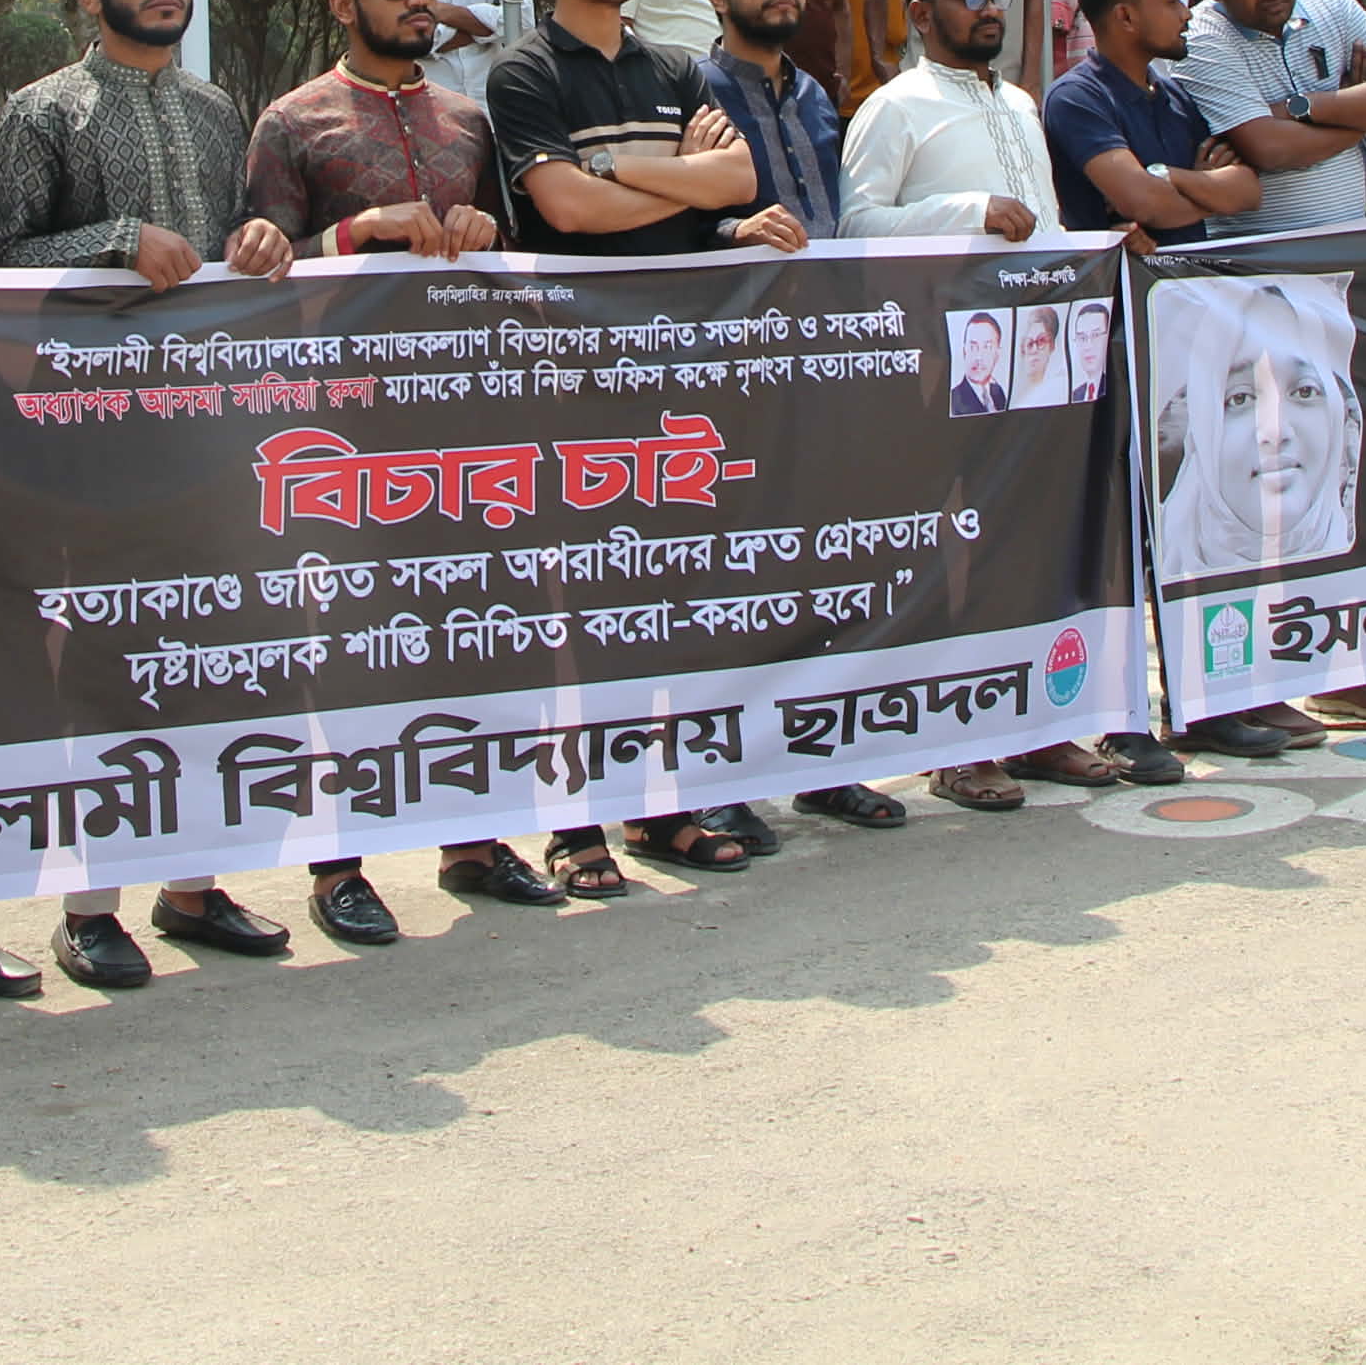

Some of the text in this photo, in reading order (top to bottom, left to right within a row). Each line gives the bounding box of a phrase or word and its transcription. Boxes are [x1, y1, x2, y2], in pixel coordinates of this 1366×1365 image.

[13, 348, 922, 425] অধ্যাপক আসমা সাদিয়া রুনা ম্যামকে তাঁর নিজ অফিস কক্ষে নৃশংস হত্যাকাণ্ডের
[160, 331, 344, 377] বিশ্ববিদ্যালয়ের
[349, 325, 492, 363] সমাজকল্যাণ
[497, 318, 602, 356] বিভাগের
[607, 314, 697, 352] সম্মানিত
[701, 307, 791, 347] সভাপতি
[798, 316, 818, 339] ও
[824, 300, 905, 341] সহকারী
[251, 427, 542, 535] বিচার
[33, 508, 982, 631] হত্যাকাণ্ডে জড়িত সকল অপরাধীদের দ্রুত গ্রেফতার ও
[124, 634, 332, 711] দৃষ্টান্তমূলক
[340, 612, 433, 670] শাস্তি
[440, 604, 572, 662] নিশ্চিত
[579, 590, 803, 647] করো-করতে
[216, 713, 743, 826] বিশ্ববিদ্যালয়
[775, 661, 1032, 757] ছাত্রদল
